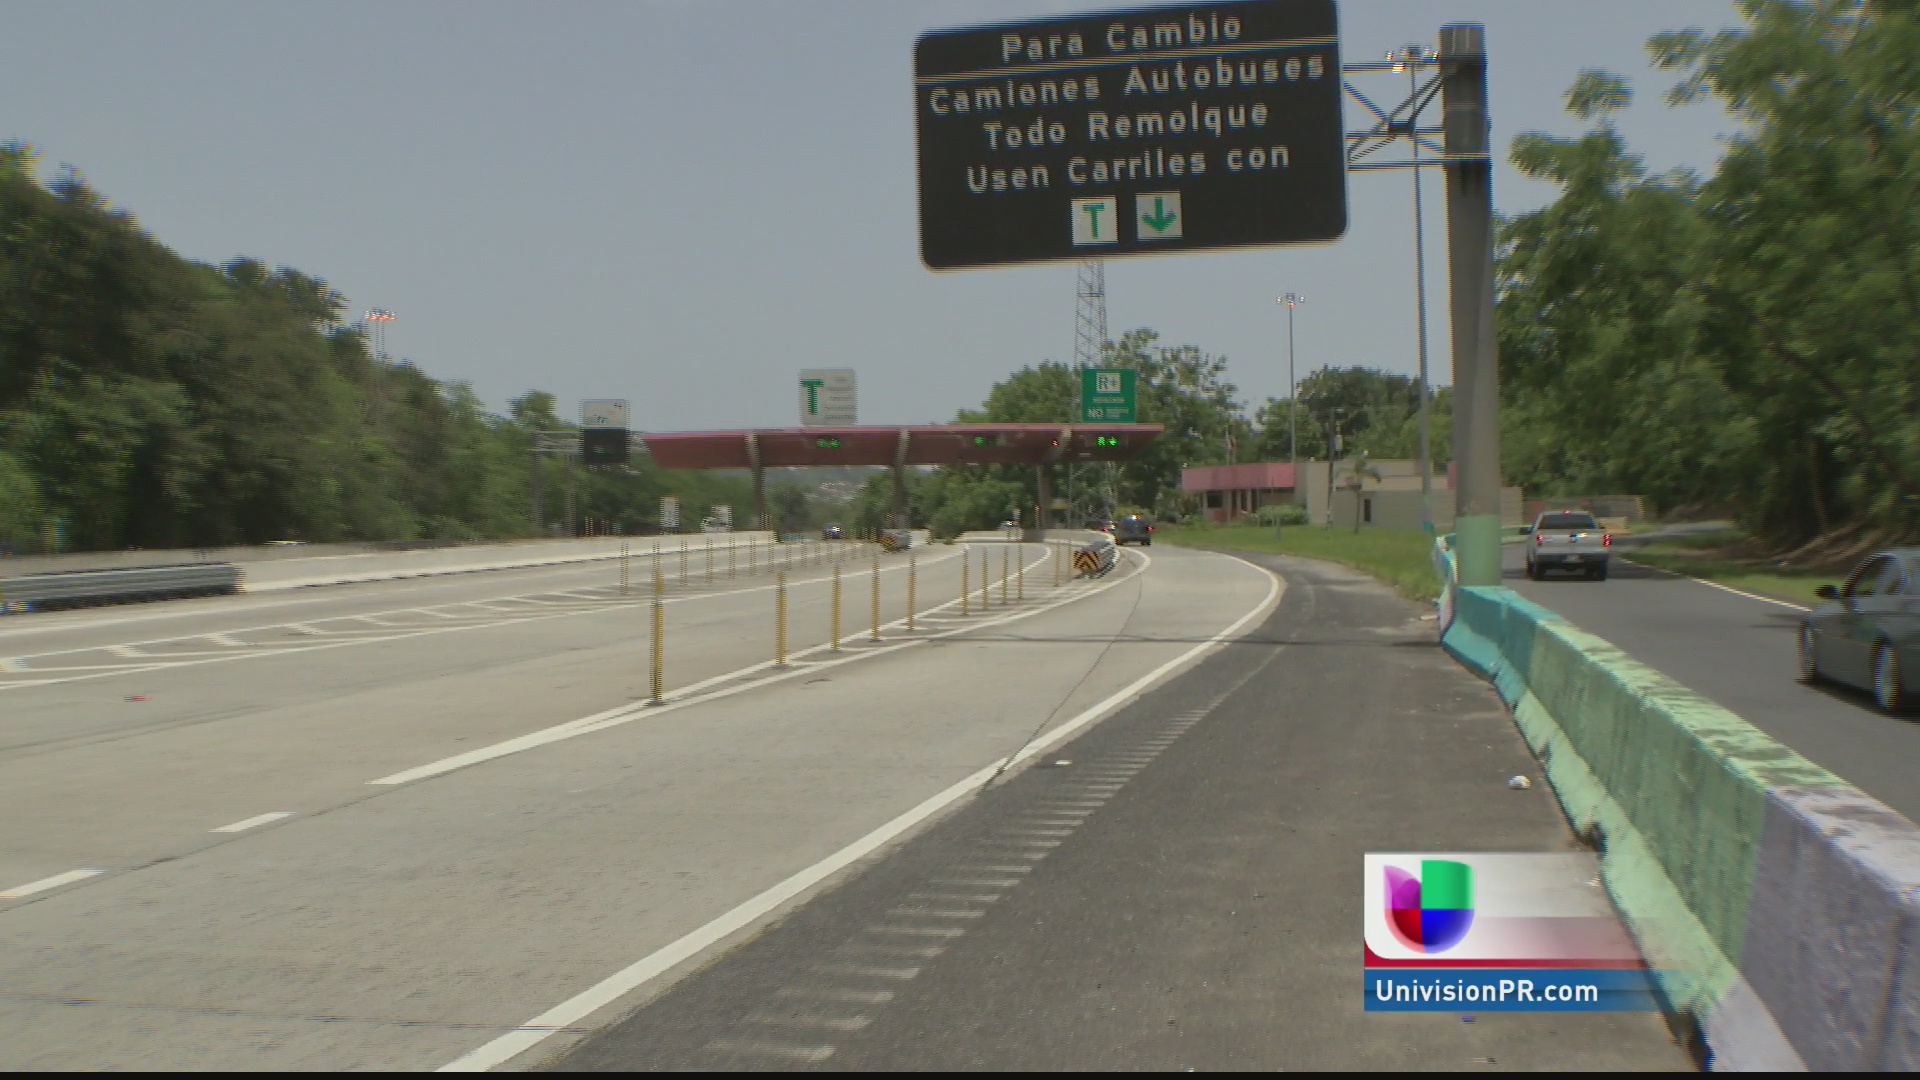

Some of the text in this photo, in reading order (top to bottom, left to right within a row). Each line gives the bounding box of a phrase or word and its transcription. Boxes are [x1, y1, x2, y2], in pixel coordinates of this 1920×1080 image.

[1002, 12, 1242, 63] Para Cambio
[929, 53, 1325, 115] Camiones Autobuses
[983, 101, 1269, 150] Todo Remolque
[967, 144, 1290, 193] Usen Carriles con
[1082, 203, 1105, 239] T
[800, 378, 824, 415] T
[1088, 407, 1104, 419] NO
